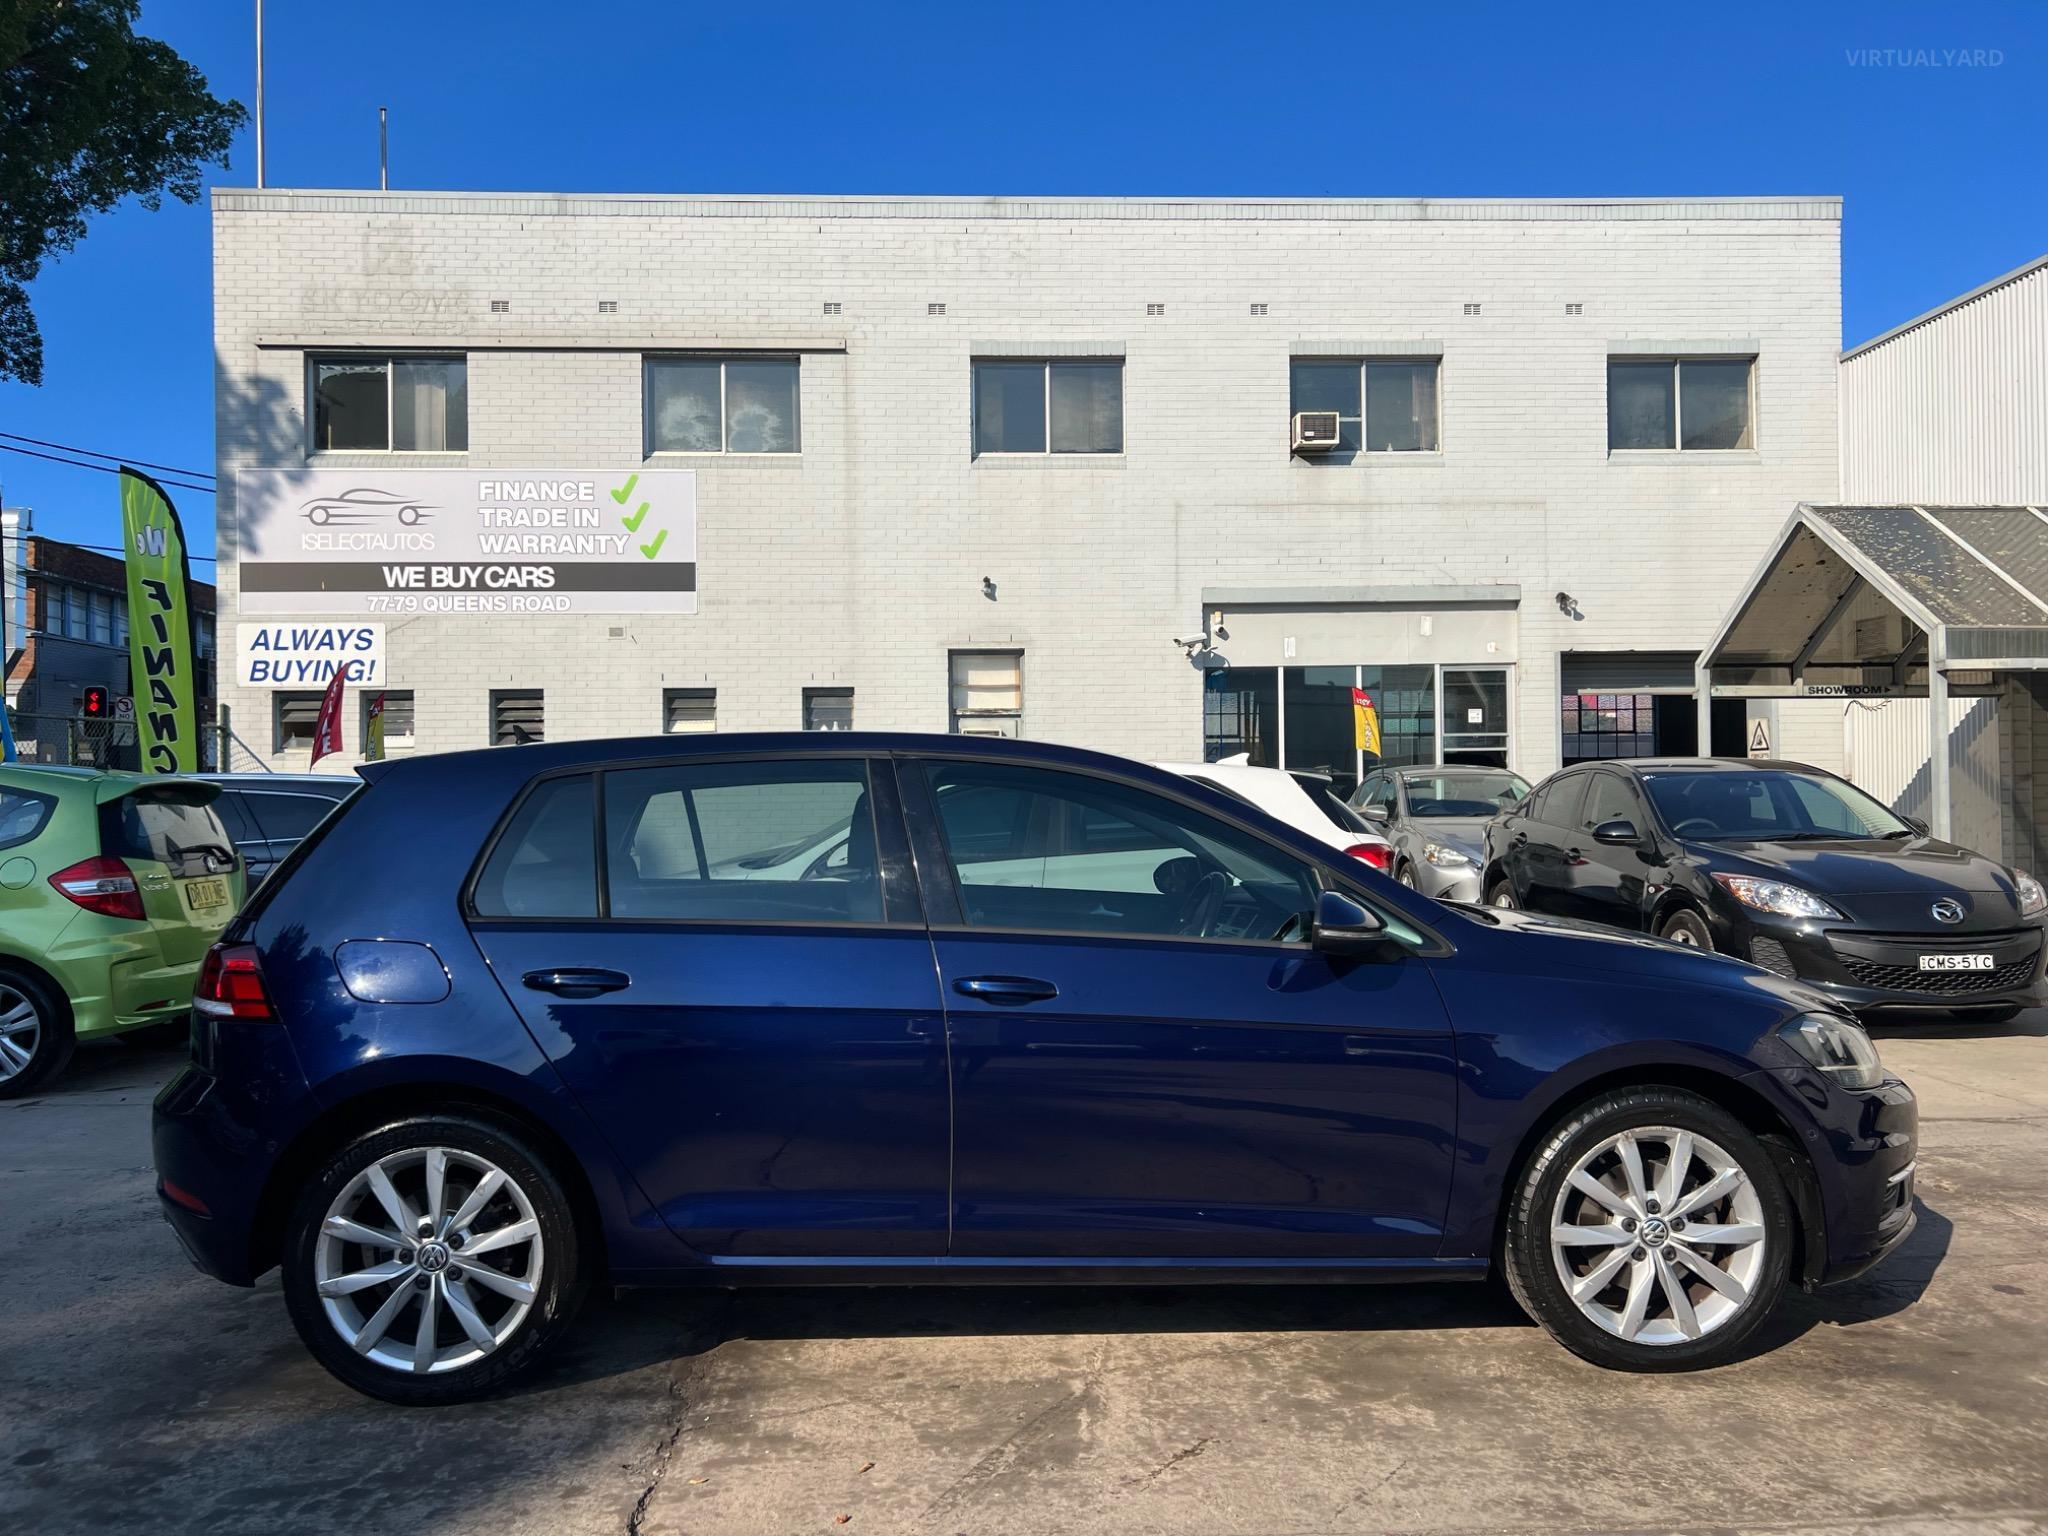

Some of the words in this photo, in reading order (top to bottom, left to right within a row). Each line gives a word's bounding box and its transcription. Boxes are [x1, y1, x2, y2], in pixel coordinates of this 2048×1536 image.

[479, 480, 595, 502] FINANCE
[478, 507, 569, 528] TRADE
[573, 507, 600, 528] IN
[478, 533, 631, 555] WARRANTY
[382, 566, 425, 588] WE
[431, 566, 484, 588] BUY
[484, 565, 556, 588] CARS
[366, 595, 418, 612] 77-79
[422, 595, 508, 613] QUEENS
[511, 595, 572, 612] ROAD
[249, 628, 374, 651] ALWAYS
[249, 658, 376, 682] BUYING!
[1808, 686, 1882, 695] SHOWROOM
